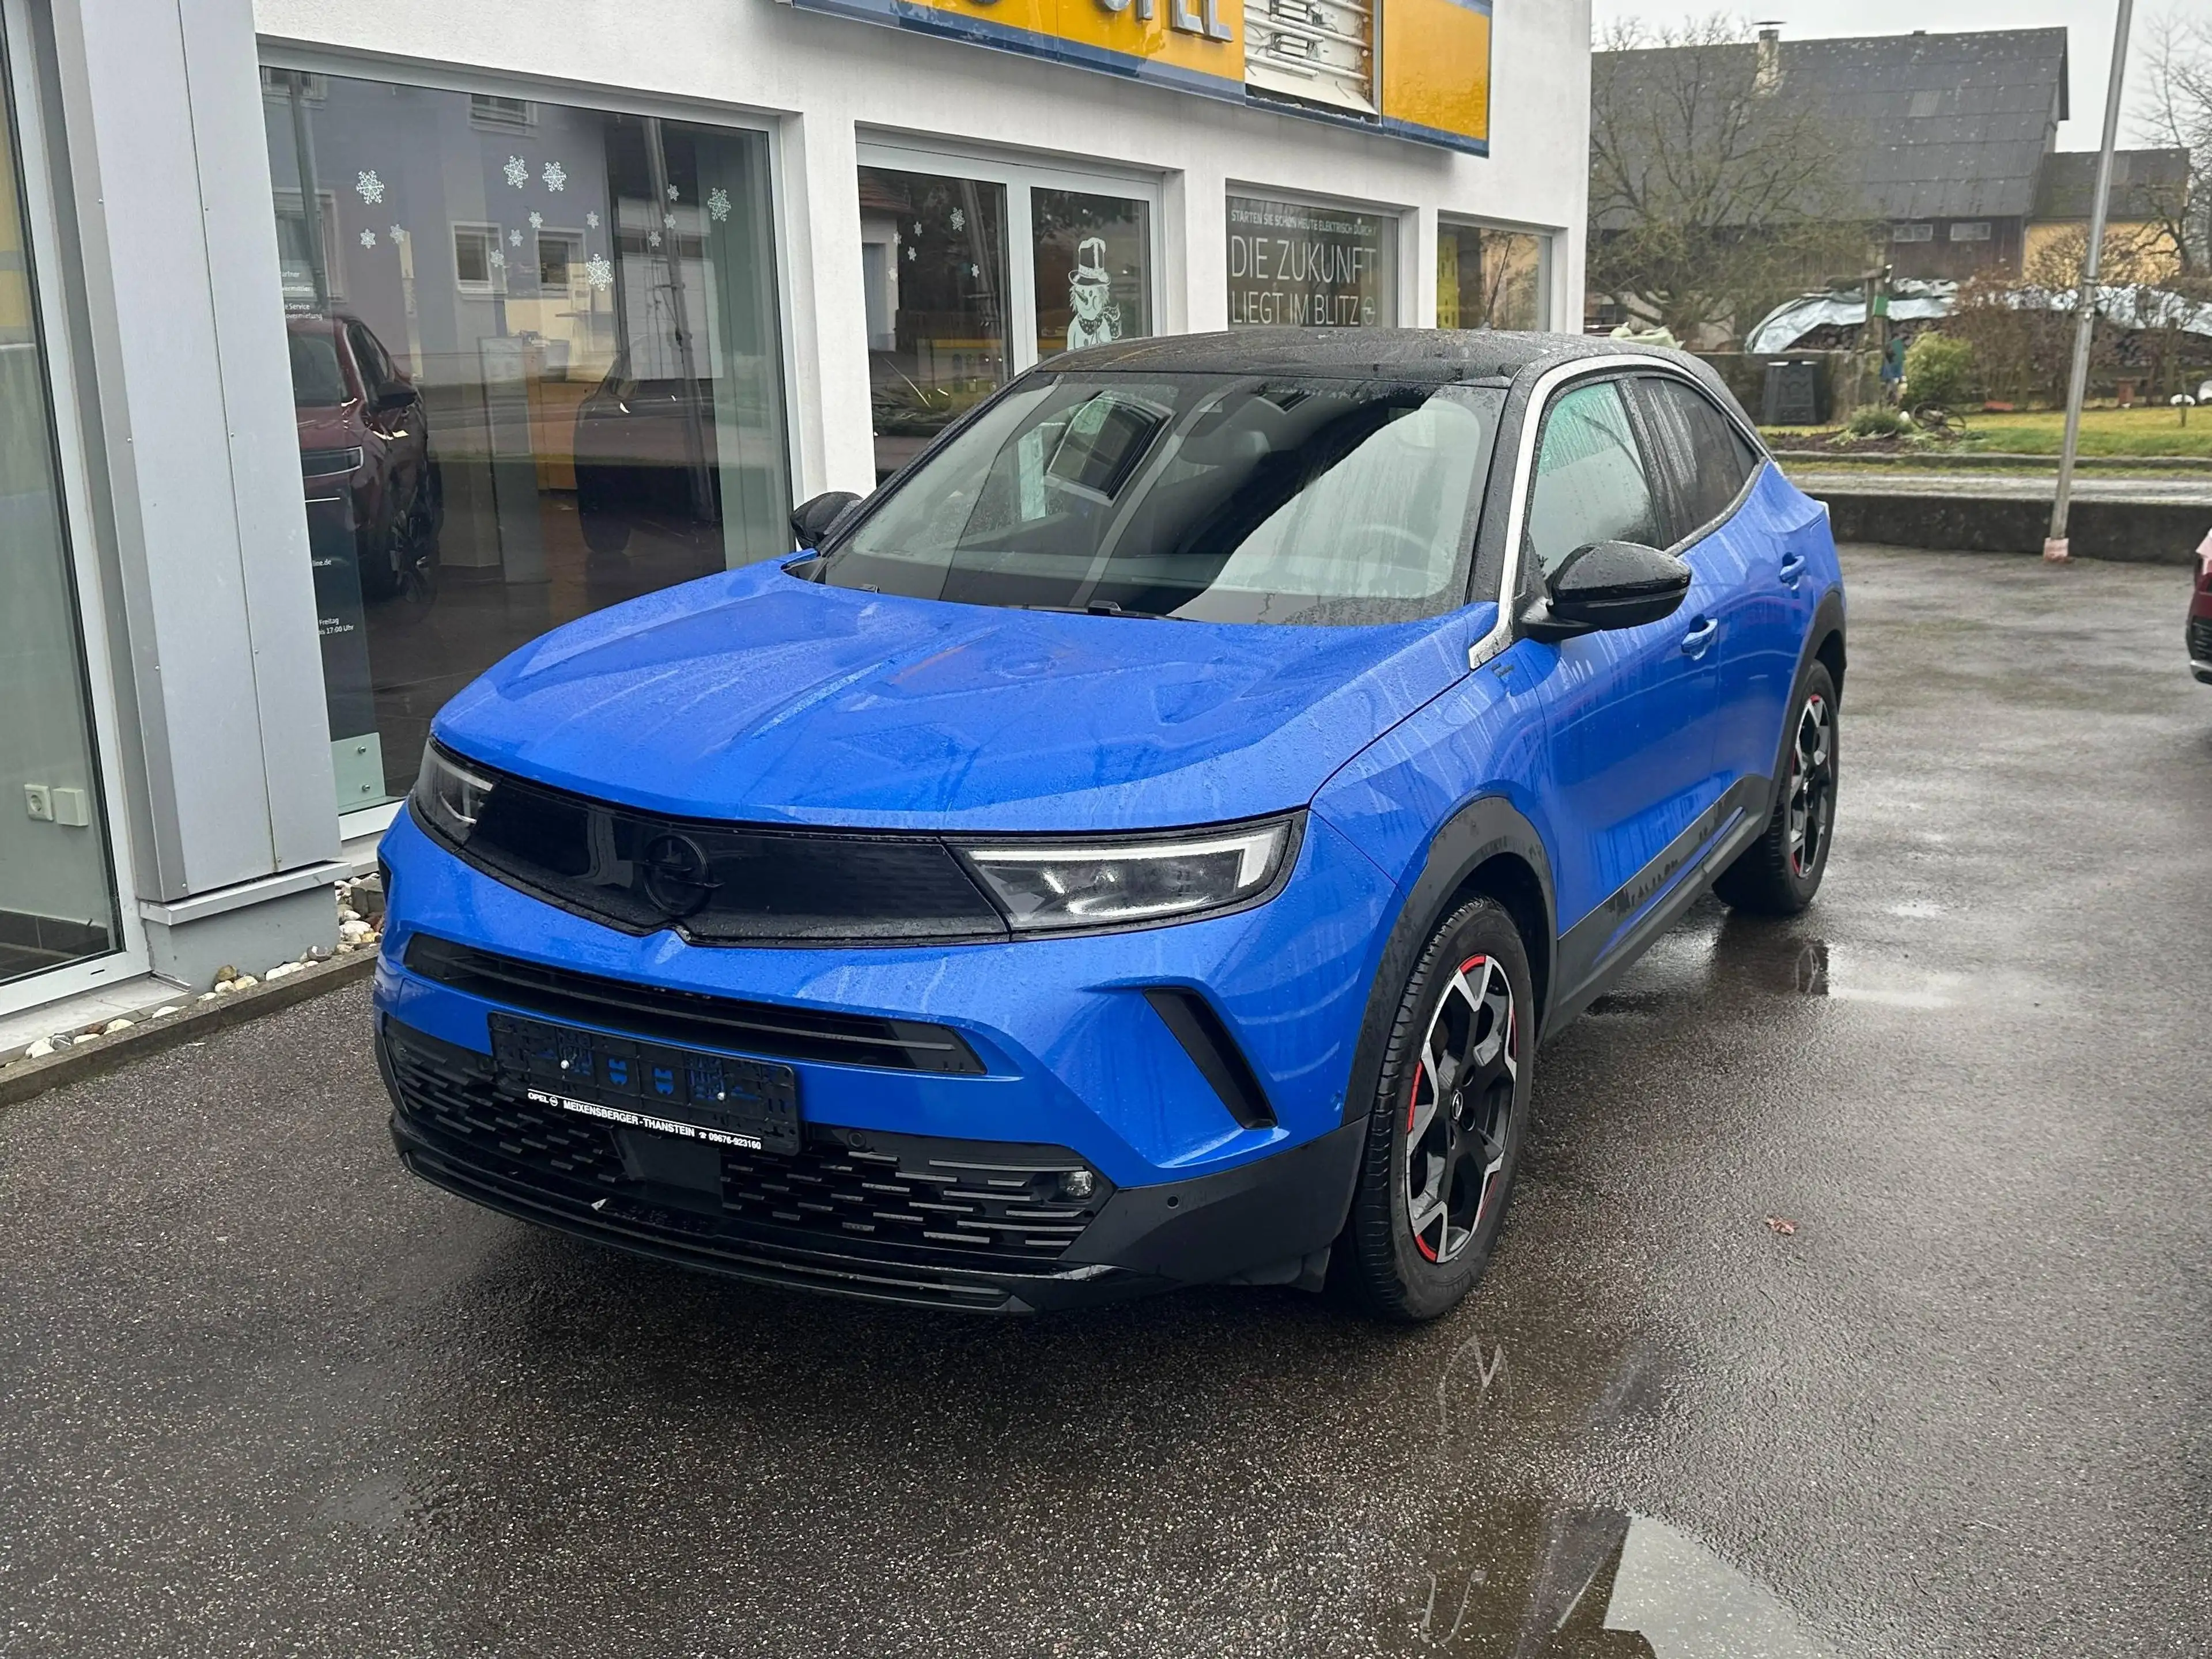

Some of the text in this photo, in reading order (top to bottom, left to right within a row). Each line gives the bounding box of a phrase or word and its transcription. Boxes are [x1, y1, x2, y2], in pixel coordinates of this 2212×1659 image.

[1231, 210, 1262, 224] STARTEN
[1264, 213, 1273, 226] SIE
[1298, 217, 1318, 230] HEUTE
[1318, 220, 1353, 234] ELEKTRISCH
[1231, 235, 1377, 286] DIE ZUKUNFT
[1232, 290, 1359, 325] LIEGT IM BLITZ
[319, 618, 339, 626] Freitag
[528, 1092, 549, 1104] OPEL
